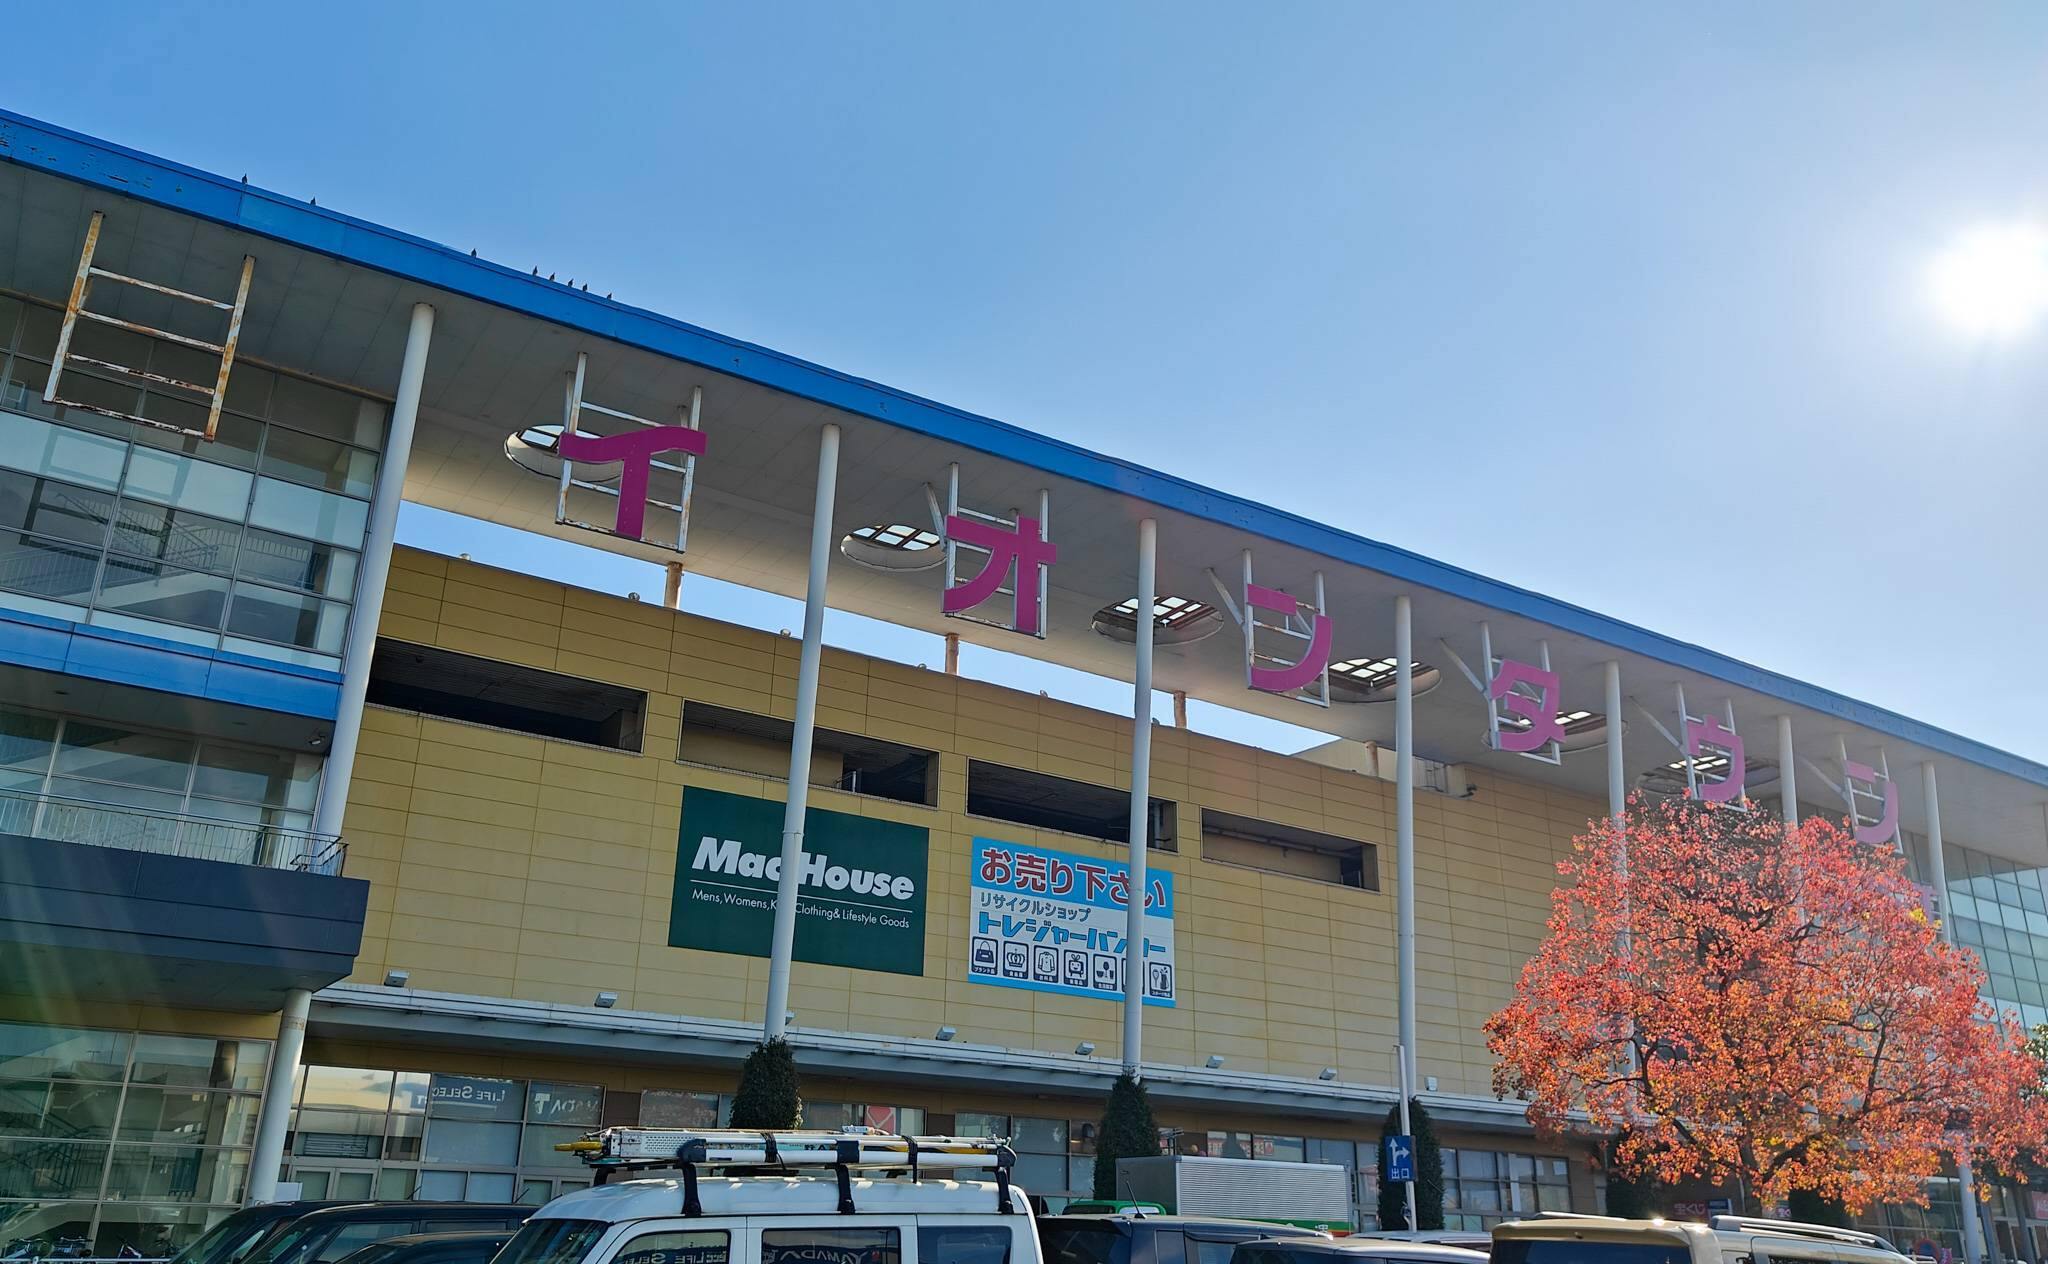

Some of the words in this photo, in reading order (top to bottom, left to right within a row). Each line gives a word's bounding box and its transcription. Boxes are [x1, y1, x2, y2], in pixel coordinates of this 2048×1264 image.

[980, 892, 1091, 922] リサイクルショップ
[842, 910, 876, 925] Lifestyle
[880, 915, 910, 929] Goods
[1391, 1167, 1410, 1180] 出口
